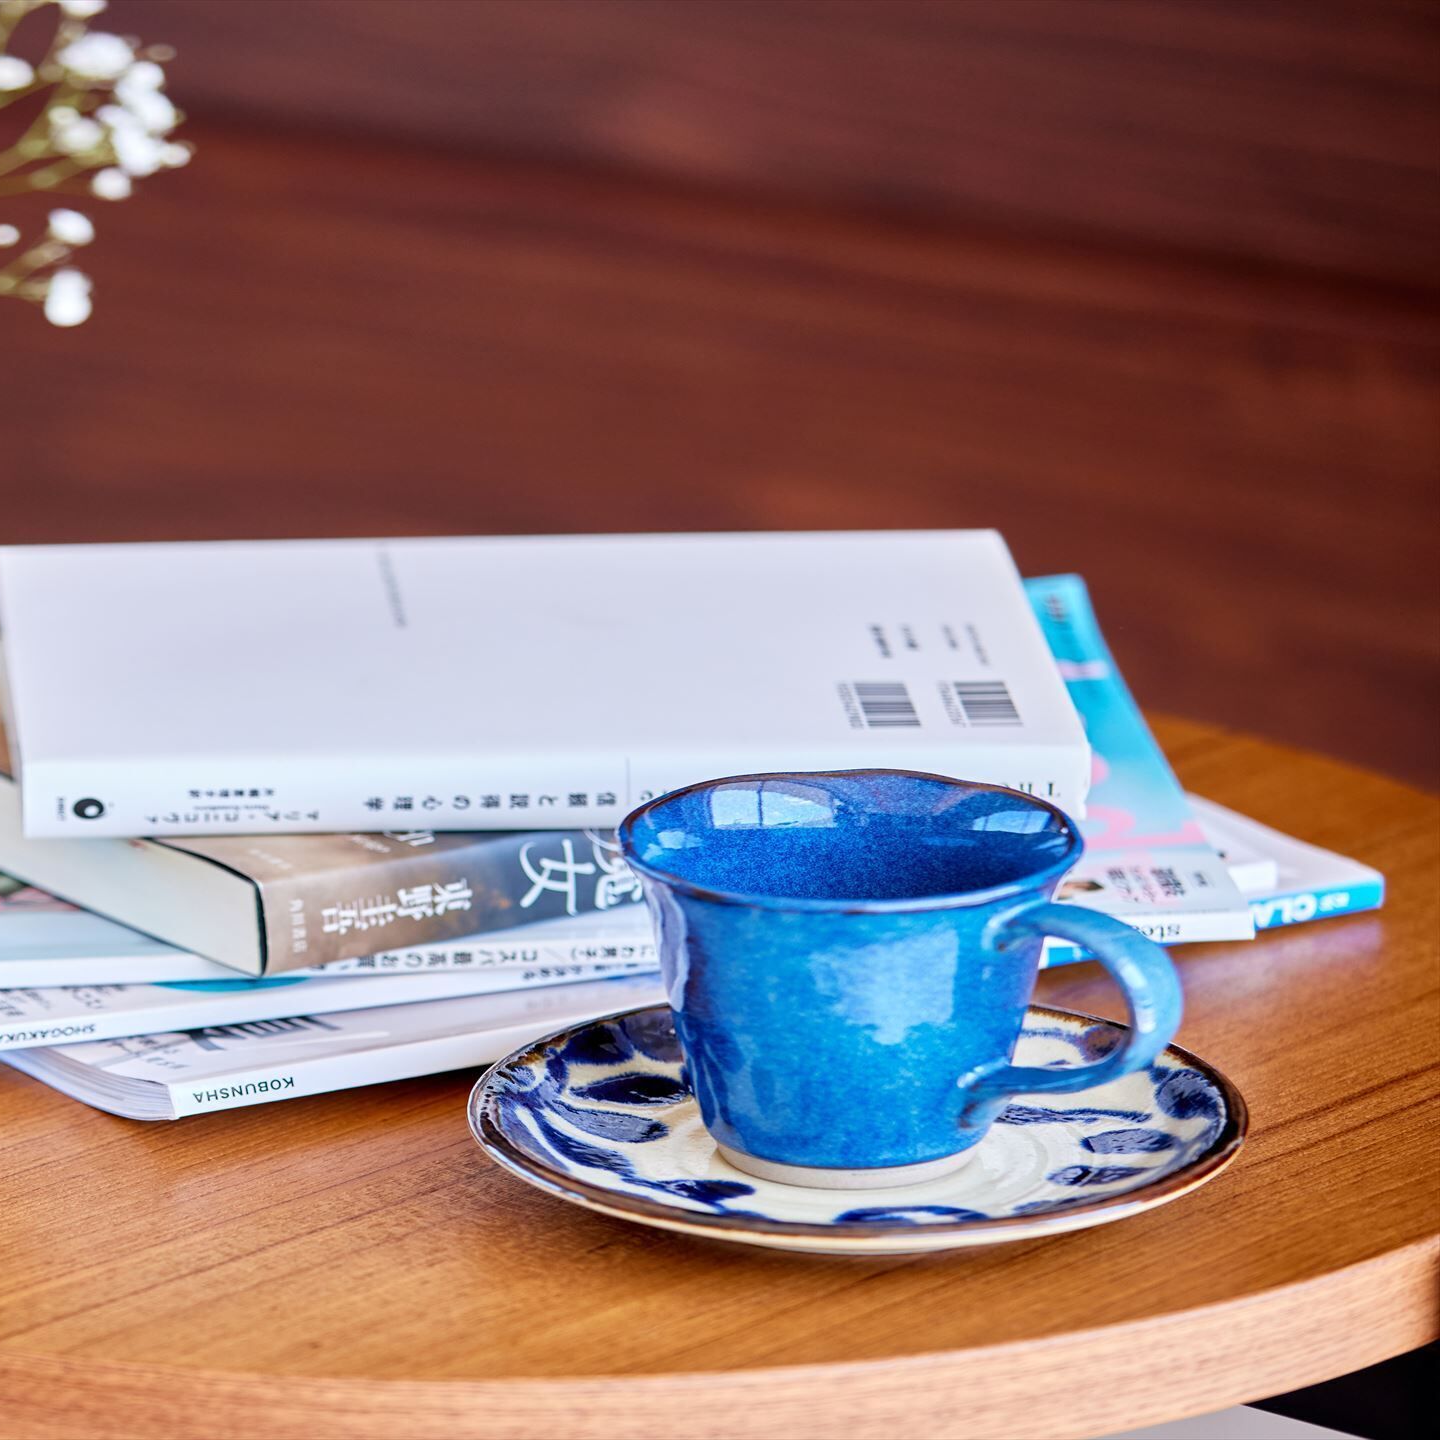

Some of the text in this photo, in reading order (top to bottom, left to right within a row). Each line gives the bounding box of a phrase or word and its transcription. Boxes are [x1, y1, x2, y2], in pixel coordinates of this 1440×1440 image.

[320, 878, 473, 936] 東野圭吾
[193, 1076, 296, 1105] KOBUNSHA
